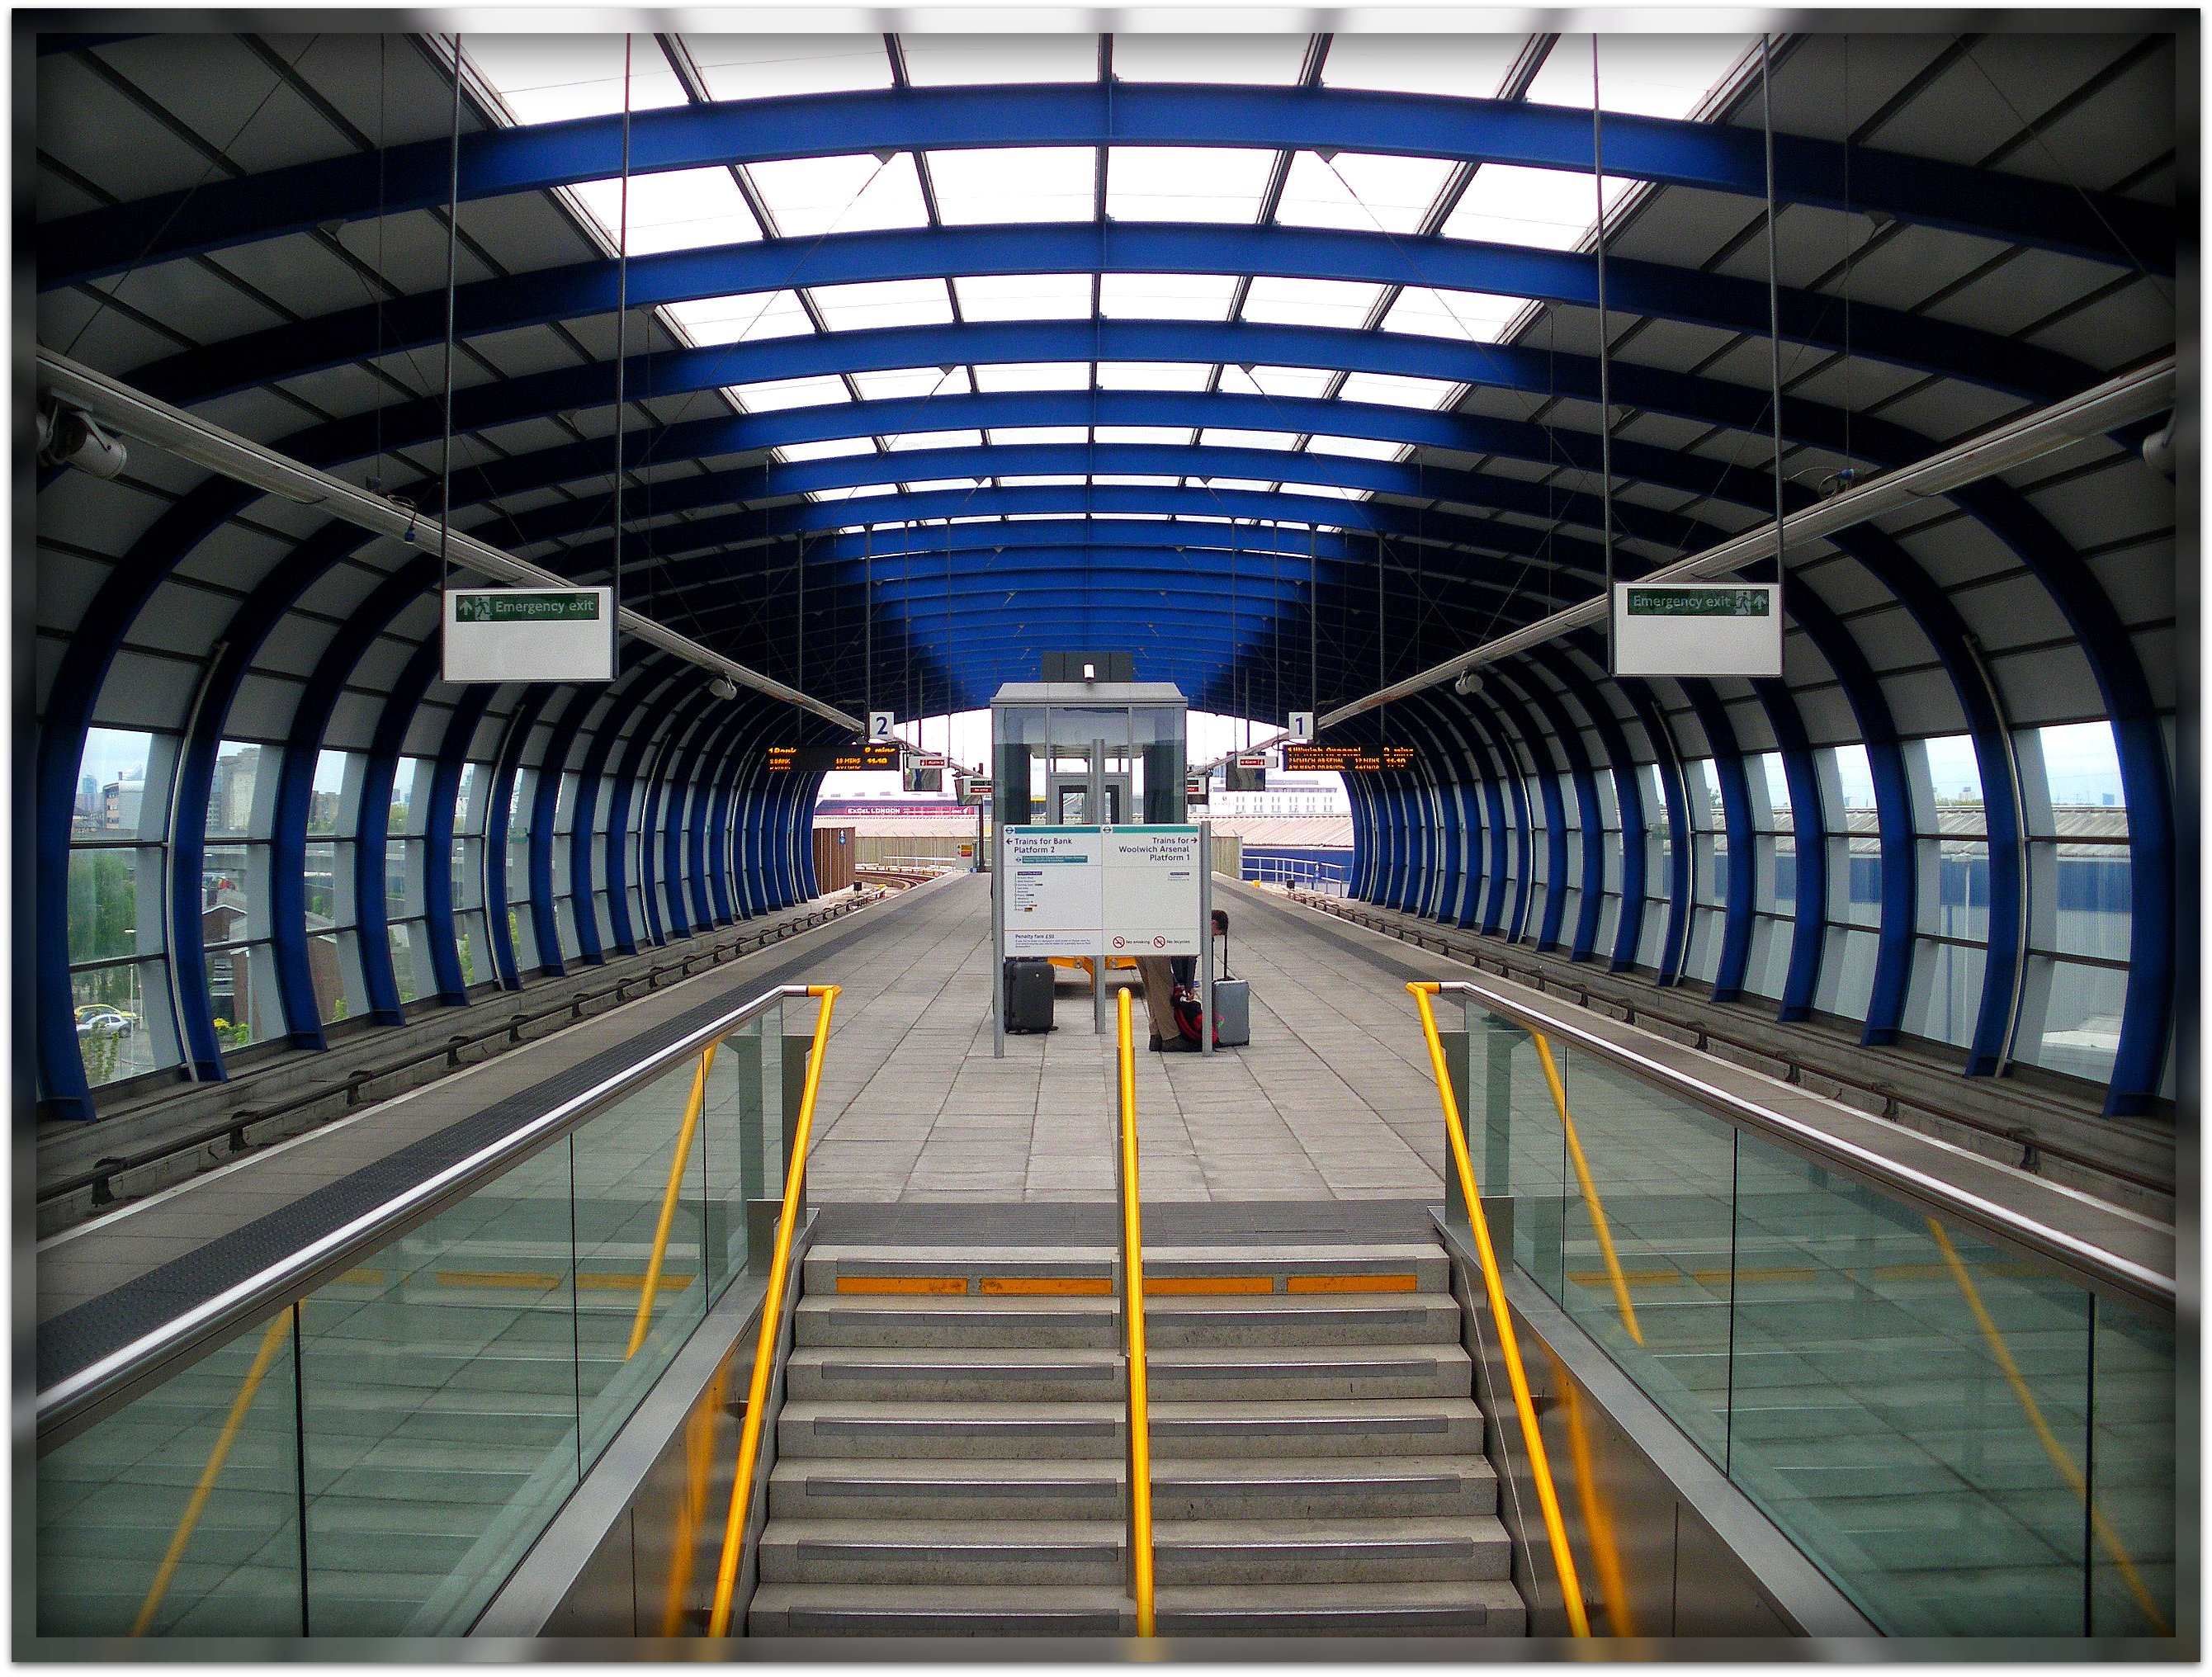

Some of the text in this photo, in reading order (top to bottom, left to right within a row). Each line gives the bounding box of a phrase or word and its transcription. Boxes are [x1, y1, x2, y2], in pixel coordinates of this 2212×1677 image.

[496, 599, 594, 614] Emergency exit
[1633, 595, 1731, 609] Emergency exit
[876, 716, 888, 735] 2
[1295, 716, 1303, 735] 1
[1039, 837, 1052, 845] for
[1177, 836, 1189, 844] for
